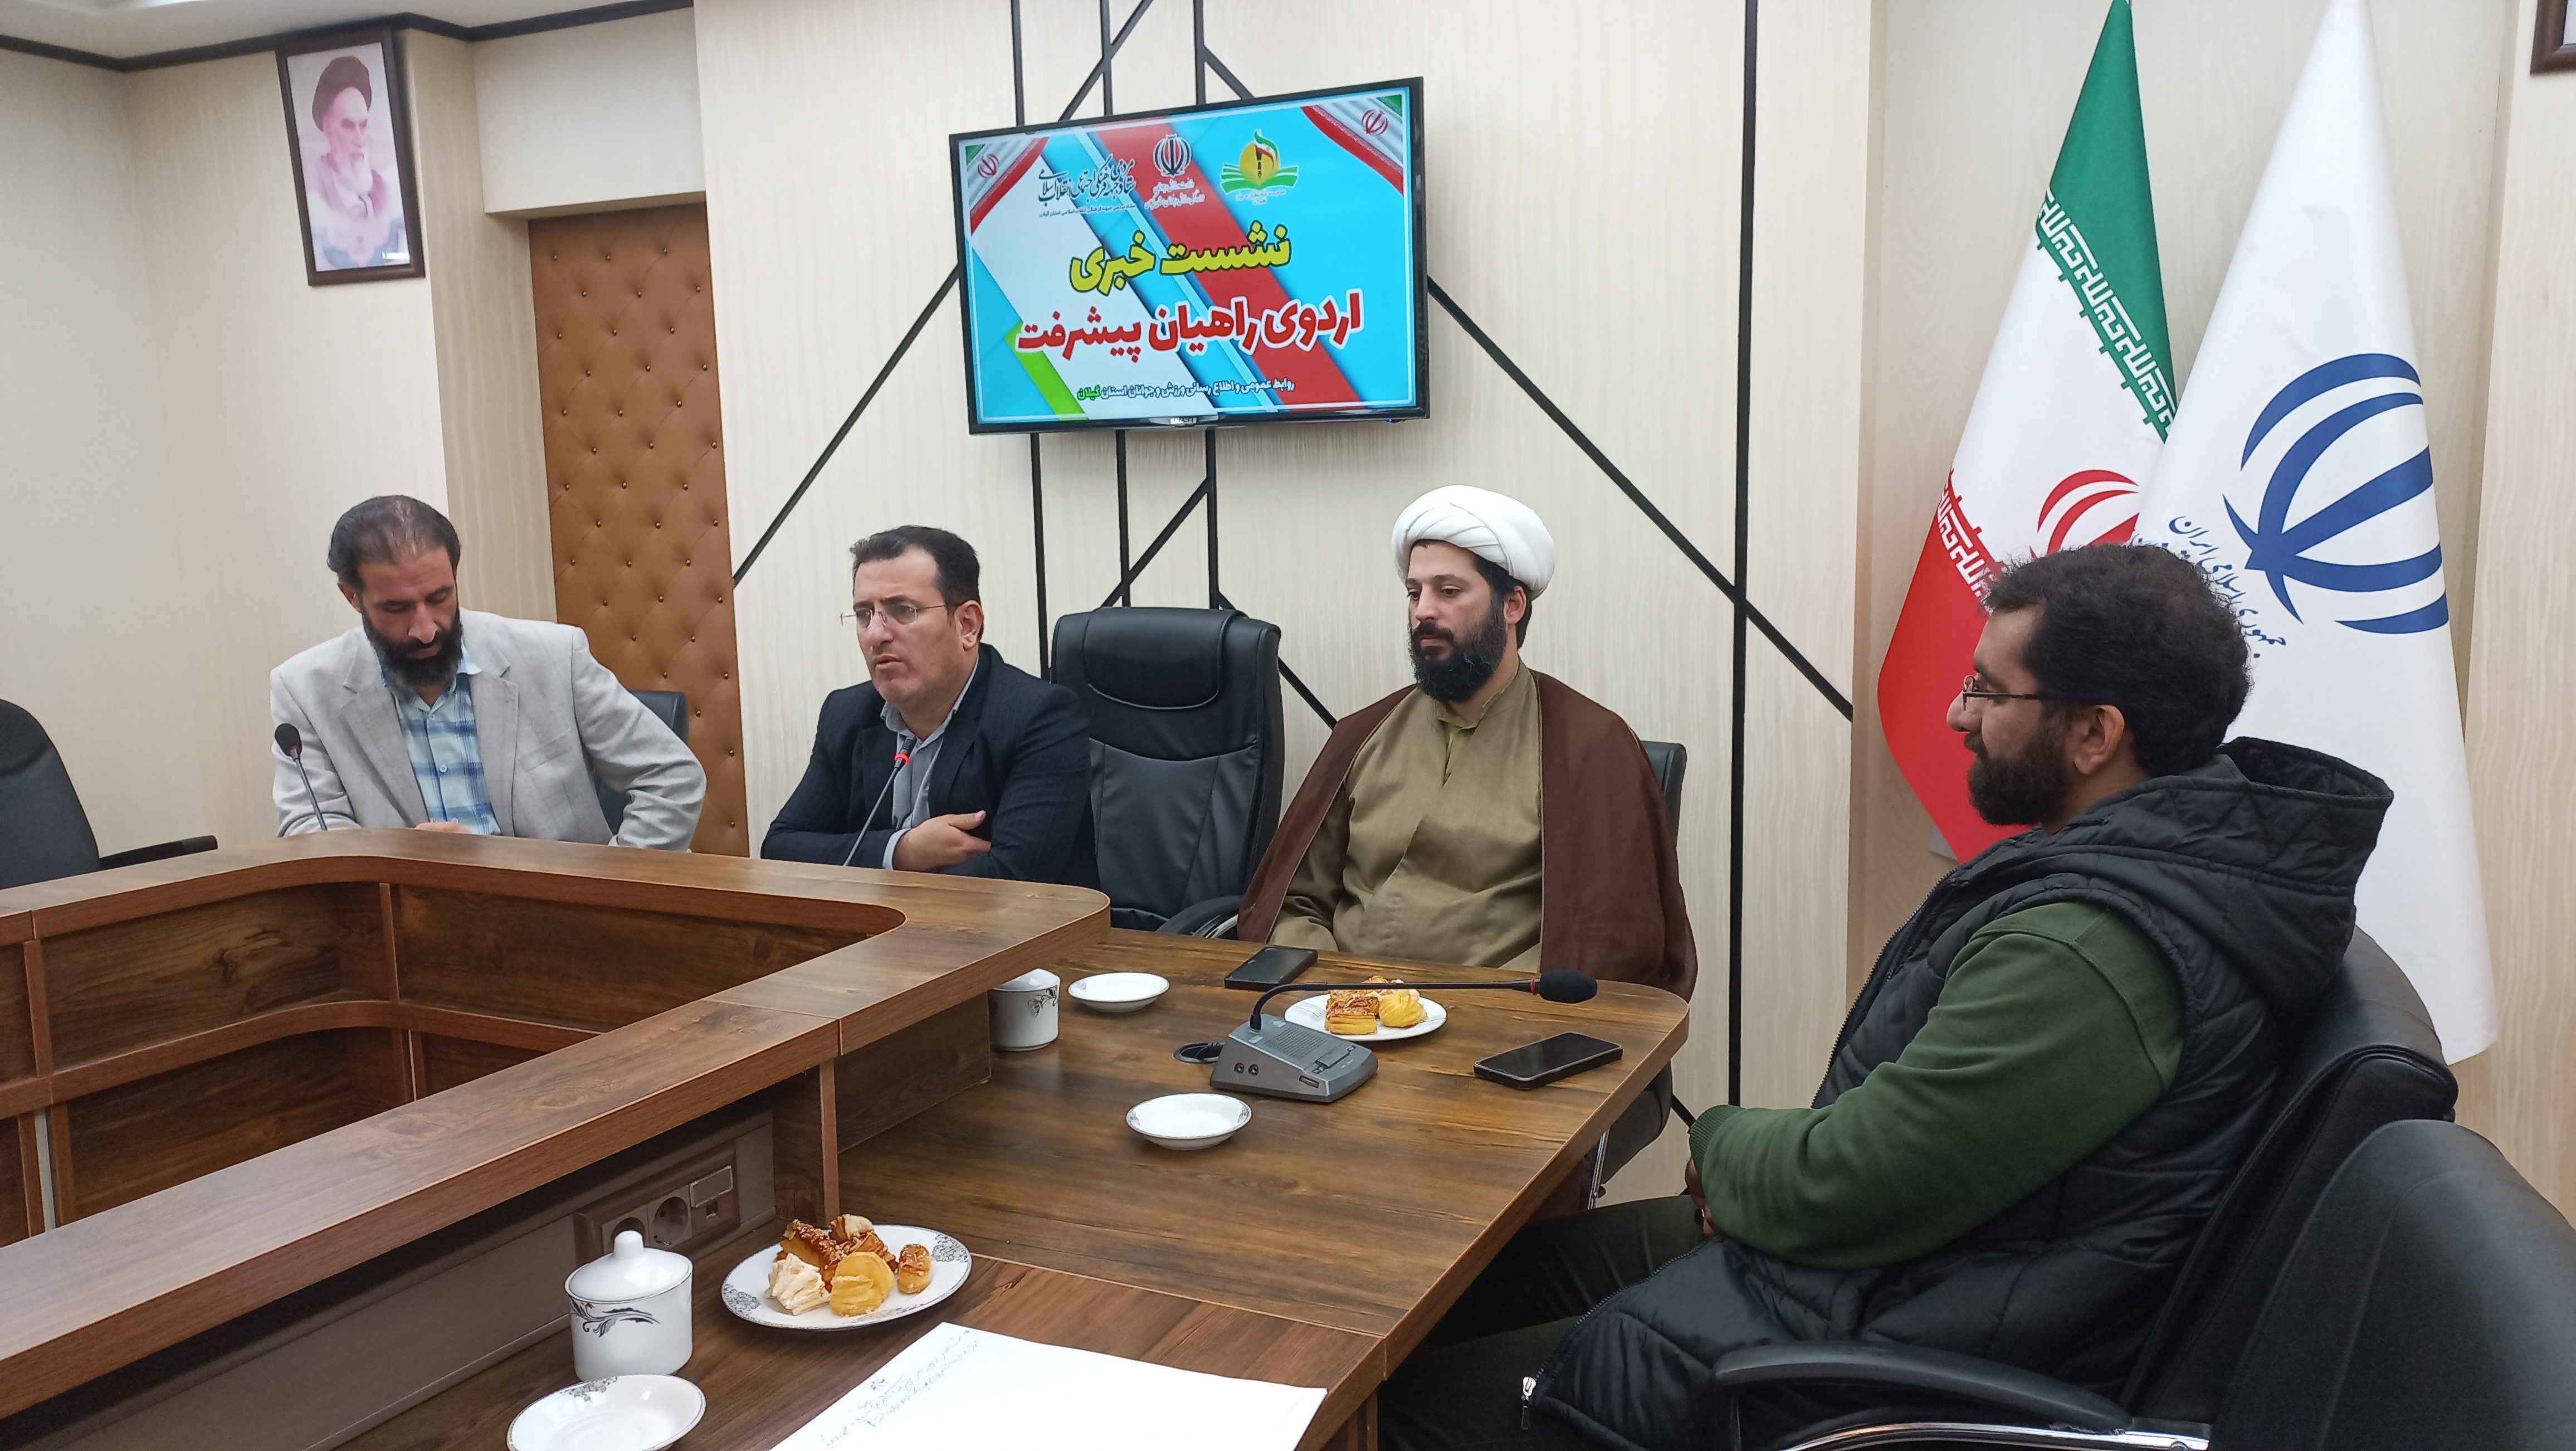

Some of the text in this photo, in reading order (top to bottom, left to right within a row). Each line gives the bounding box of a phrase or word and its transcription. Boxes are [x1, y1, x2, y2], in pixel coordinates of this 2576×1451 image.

[1070, 221, 1291, 295] نشست خبری
[1015, 289, 1364, 364] اردوی راهیان پیشرفت
[1077, 377, 1295, 401] روابط عمومی و اطلاع رسانی ورزش و جوانان استان گیلان
[2169, 515, 2220, 559] ایران
